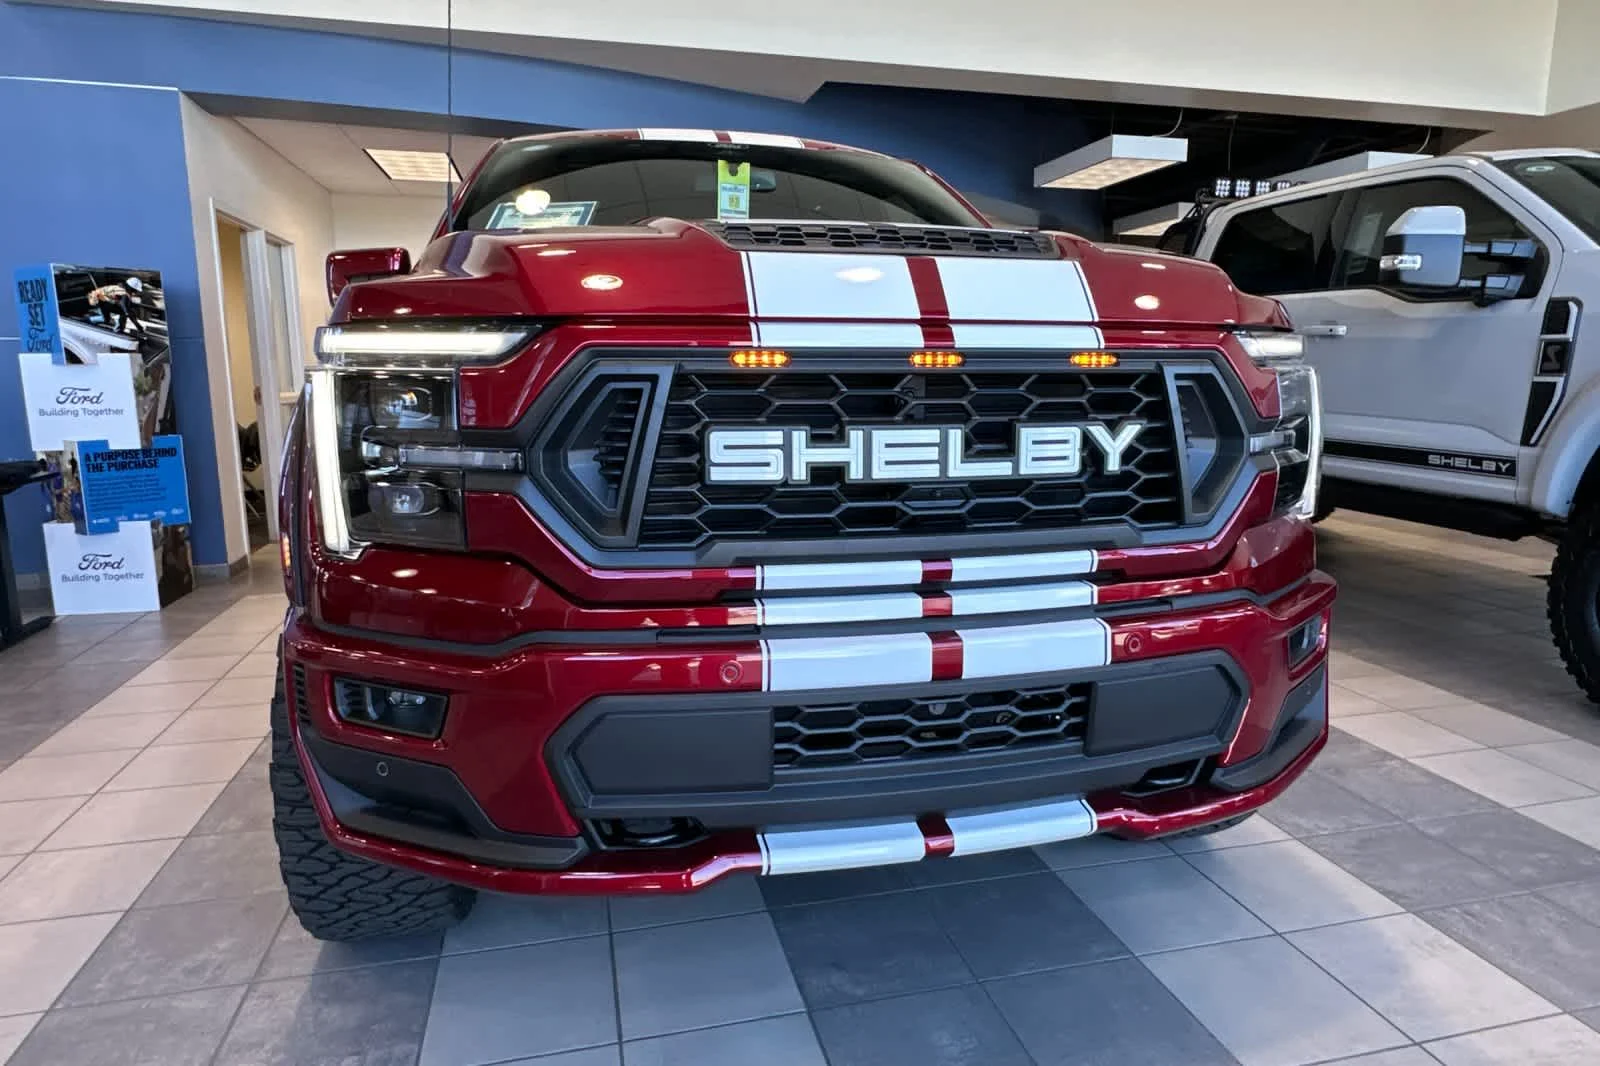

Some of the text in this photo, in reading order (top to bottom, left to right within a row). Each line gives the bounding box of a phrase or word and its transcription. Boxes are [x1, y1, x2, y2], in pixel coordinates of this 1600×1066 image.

[17, 278, 48, 304] READY
[27, 303, 46, 327] SET
[27, 327, 54, 352] Ford
[56, 386, 104, 405] Ford
[39, 407, 124, 417] Building Together
[84, 447, 177, 463] A PURPOSE BEHIND
[706, 419, 1145, 483] SHELBY
[87, 458, 159, 473] THE PURCHASE
[1427, 454, 1512, 473] SHELBY
[78, 553, 125, 570] Ford
[61, 572, 144, 583] Building Together
